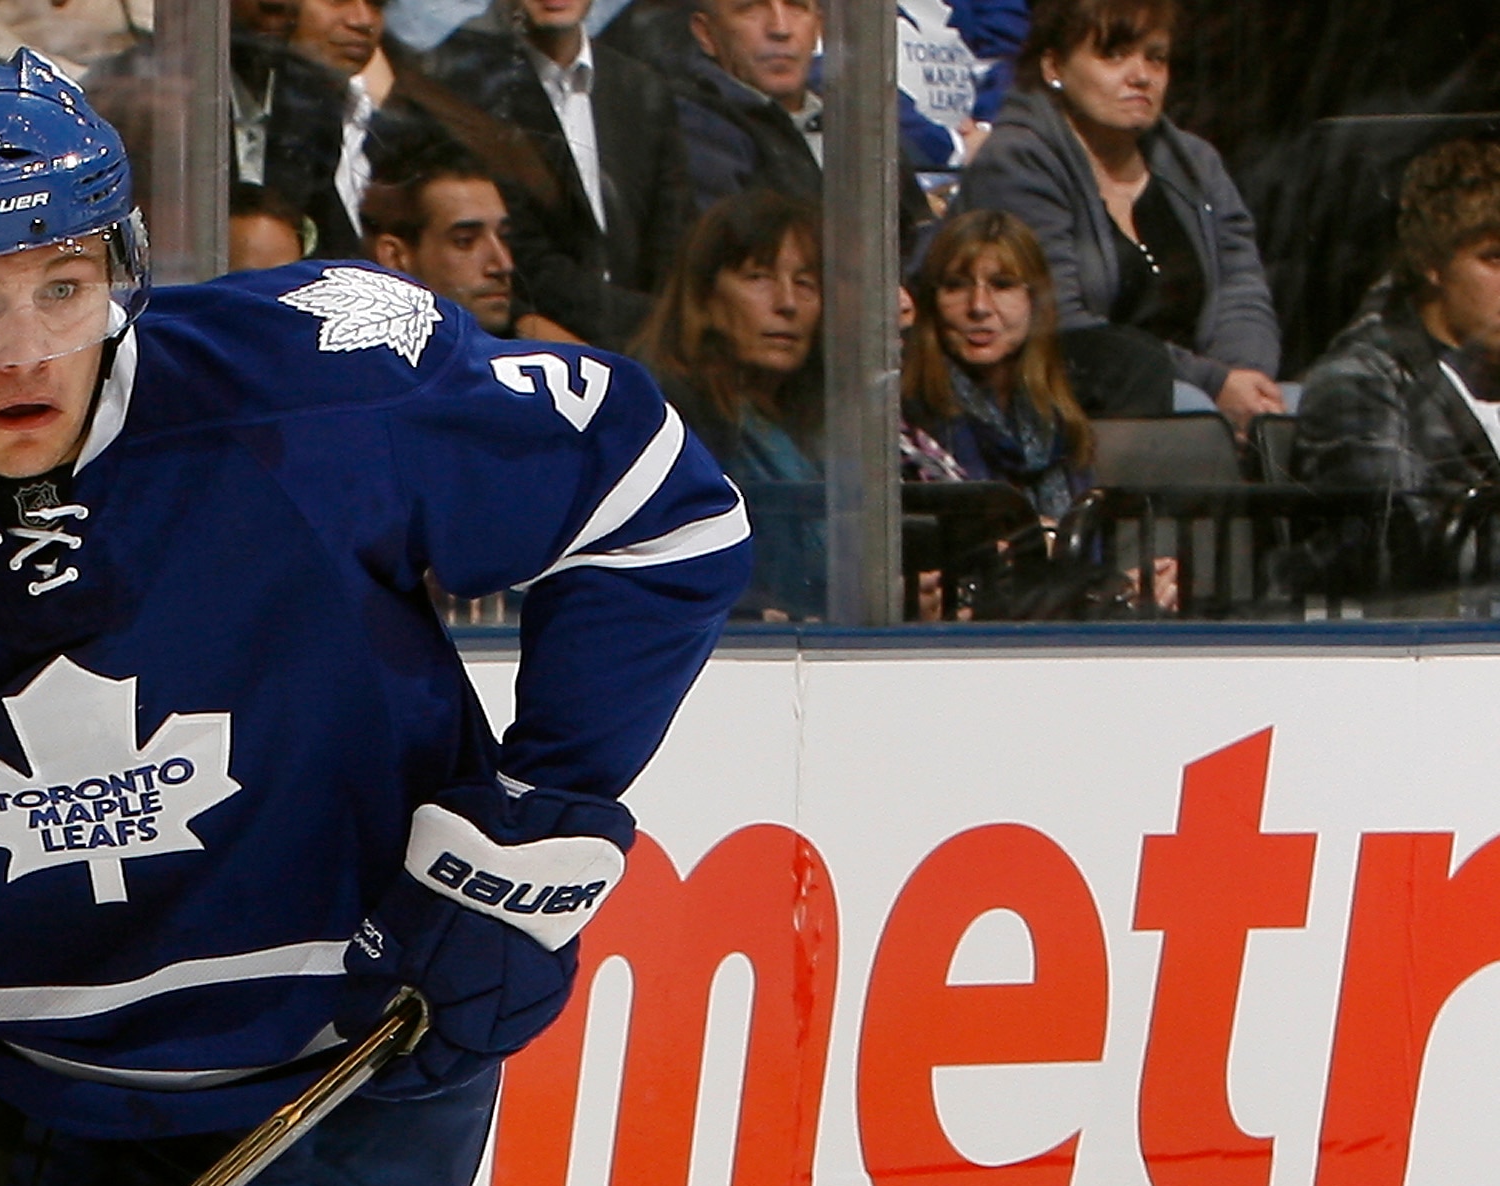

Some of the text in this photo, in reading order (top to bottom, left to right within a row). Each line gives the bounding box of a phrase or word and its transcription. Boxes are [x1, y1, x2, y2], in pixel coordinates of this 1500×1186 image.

[489, 352, 612, 432] 2
[29, 791, 163, 828] MAPLE
[41, 816, 159, 852] LEAFS
[427, 851, 607, 914] BAUER
